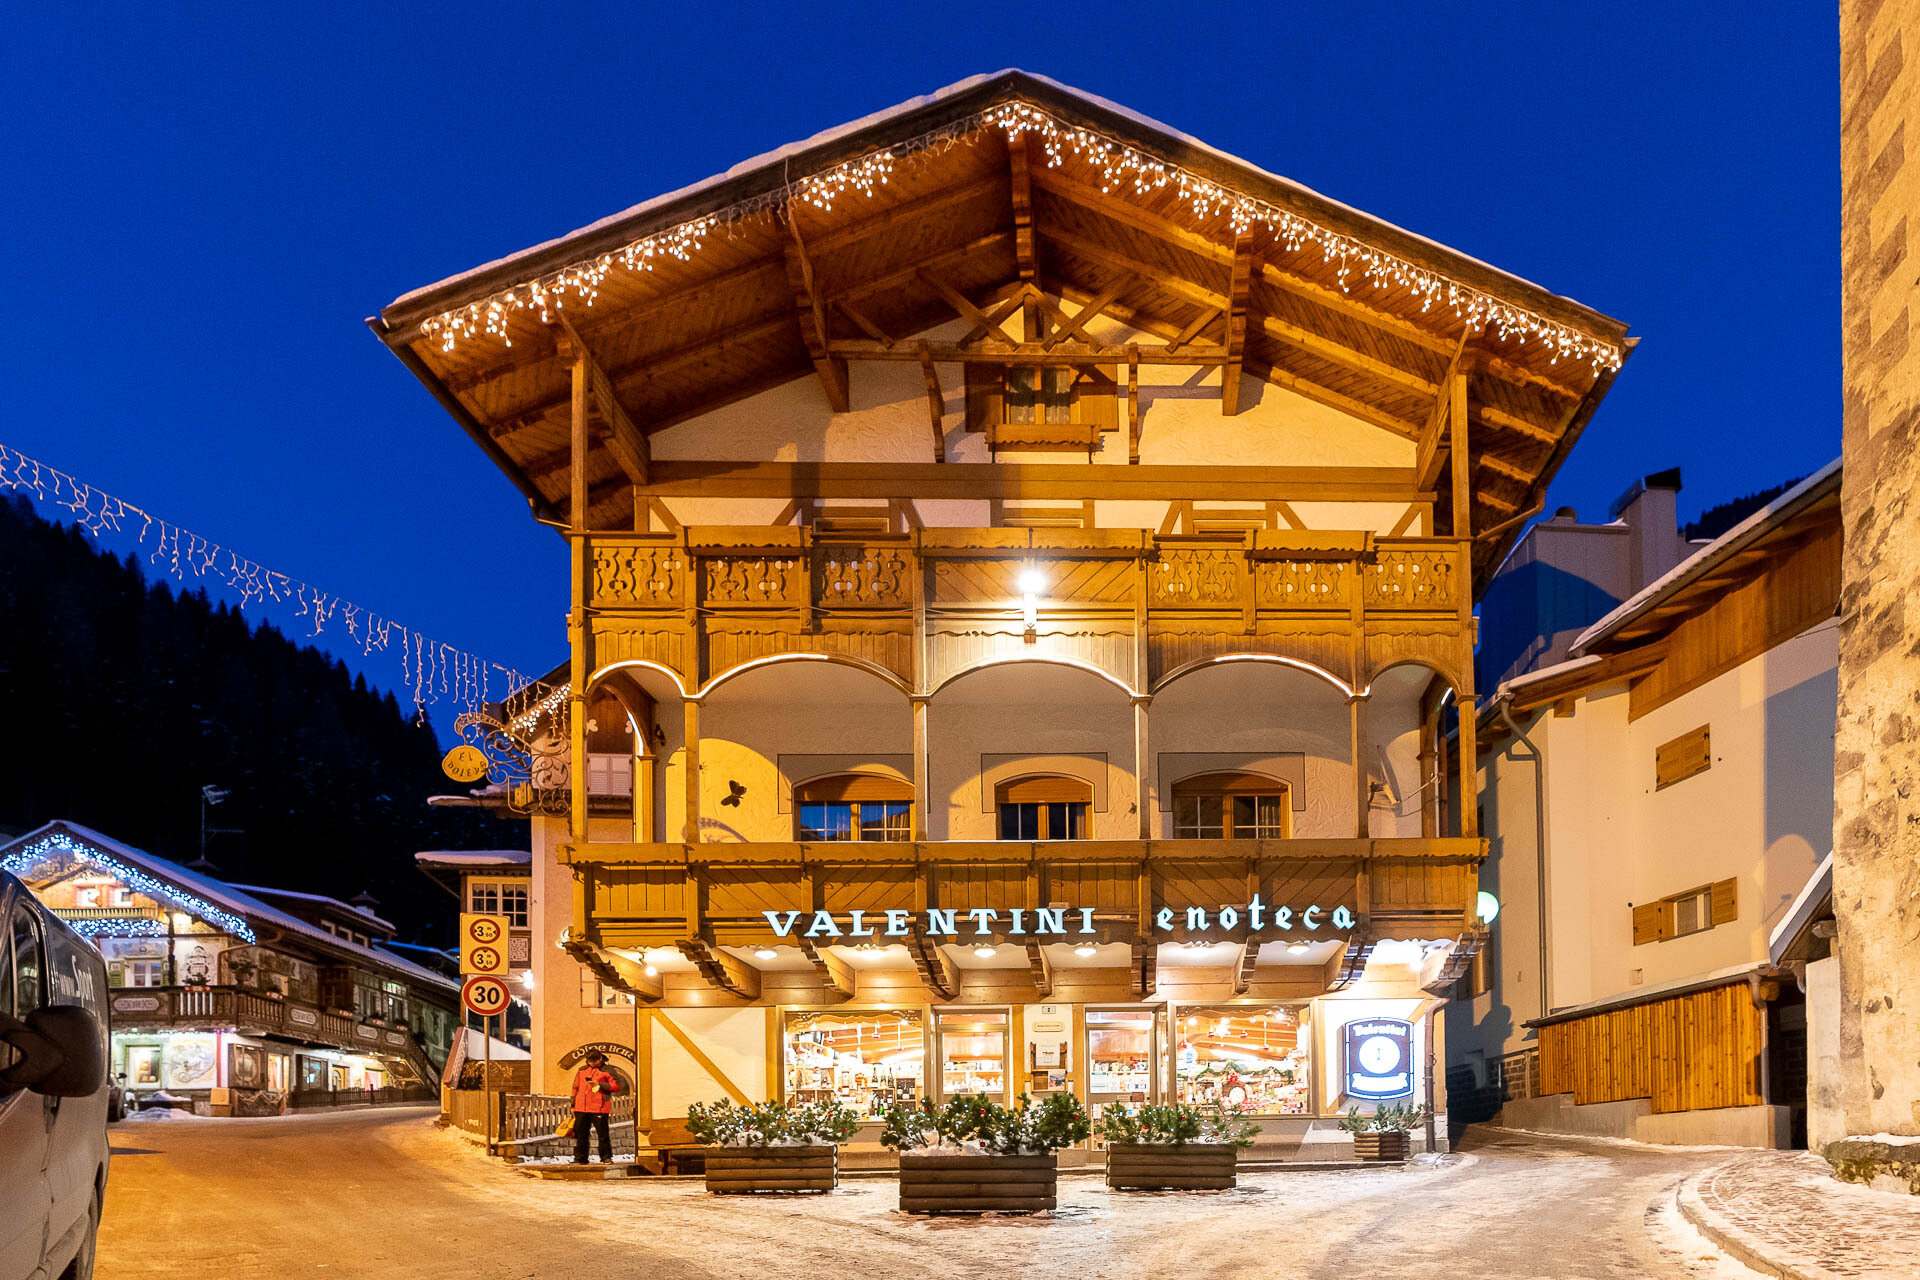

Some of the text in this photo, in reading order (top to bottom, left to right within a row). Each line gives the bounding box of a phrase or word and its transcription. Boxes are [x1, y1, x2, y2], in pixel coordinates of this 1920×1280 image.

[762, 907, 1096, 937] VALENTINI
[1157, 893, 1356, 931] enoteca
[474, 986, 500, 1004] 30
